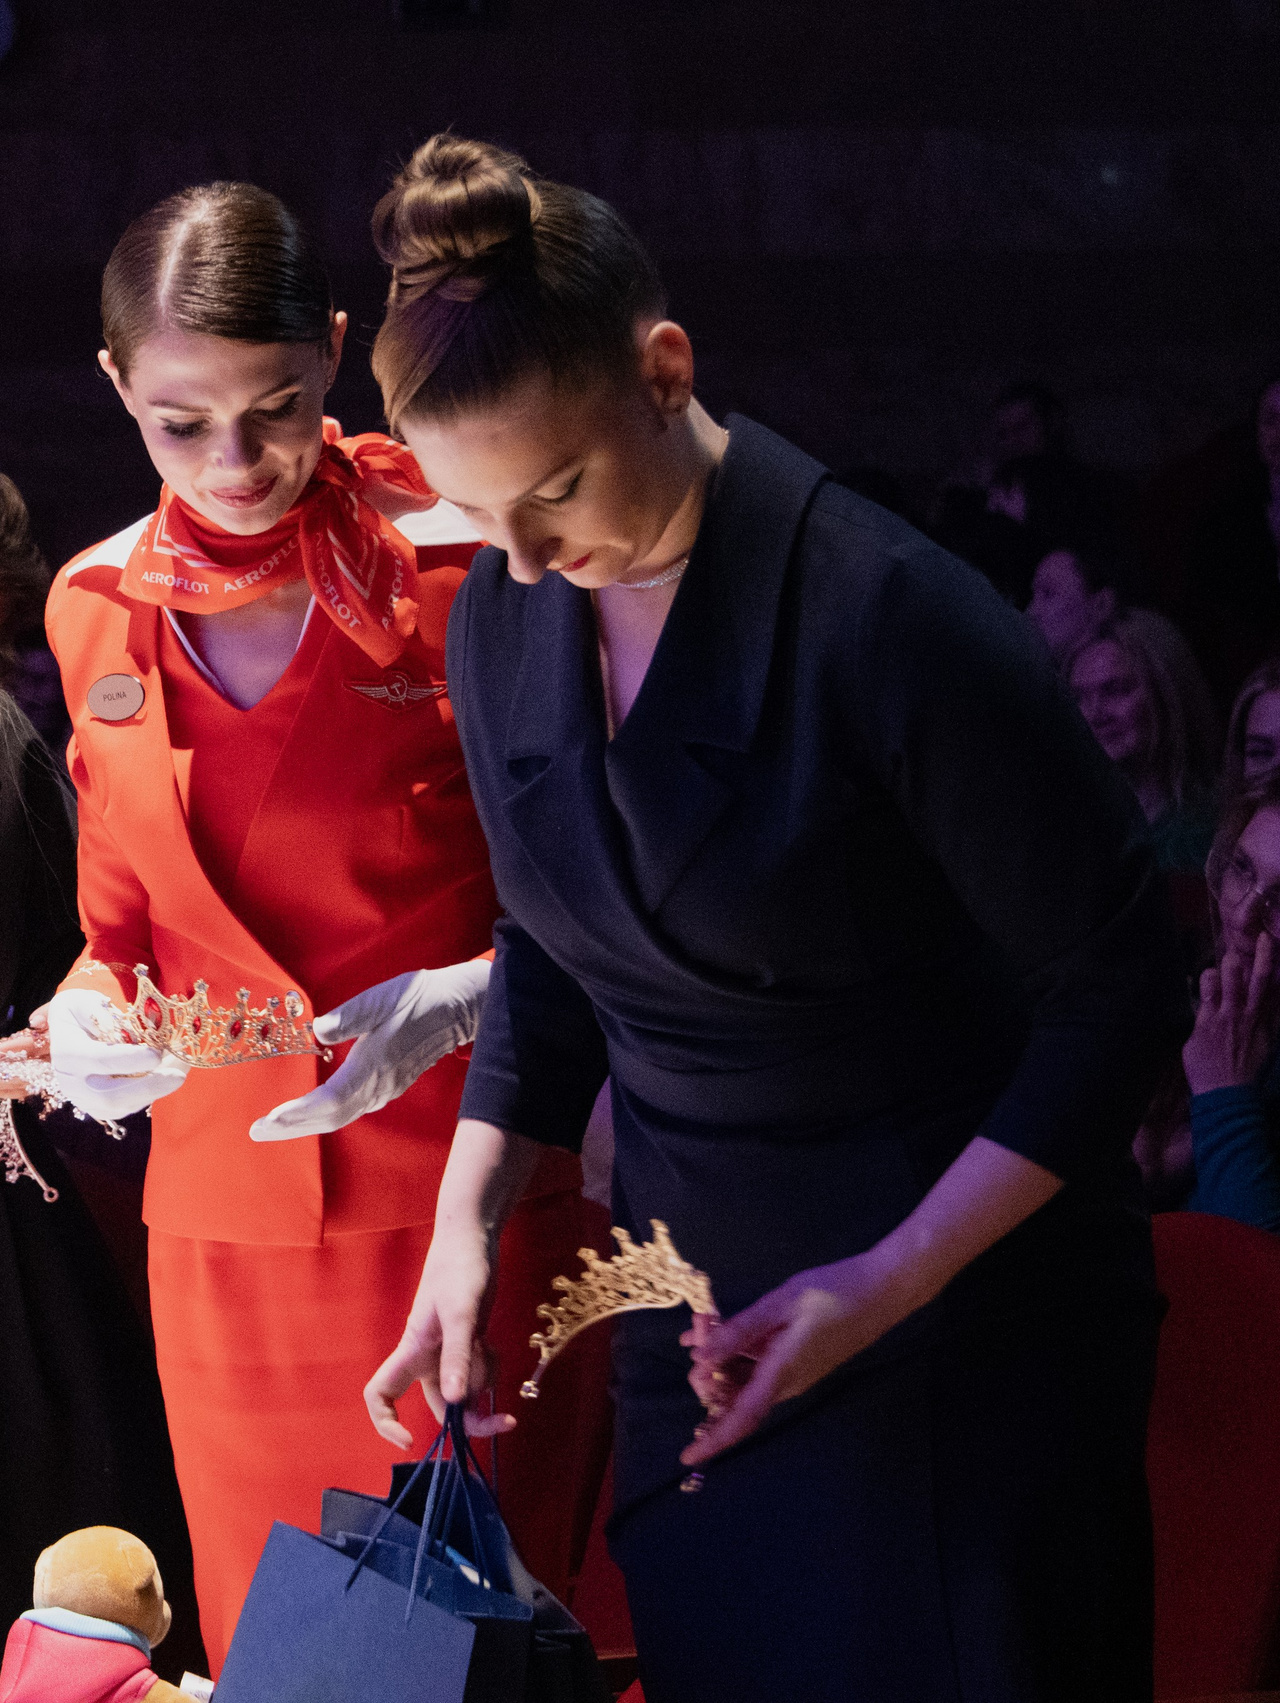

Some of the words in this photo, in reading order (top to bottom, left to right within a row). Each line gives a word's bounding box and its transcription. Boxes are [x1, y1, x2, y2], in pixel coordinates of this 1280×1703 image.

[223, 534, 300, 594] AEROFLO
[141, 571, 210, 594] AEROFLOT
[103, 691, 127, 702] POLINA
